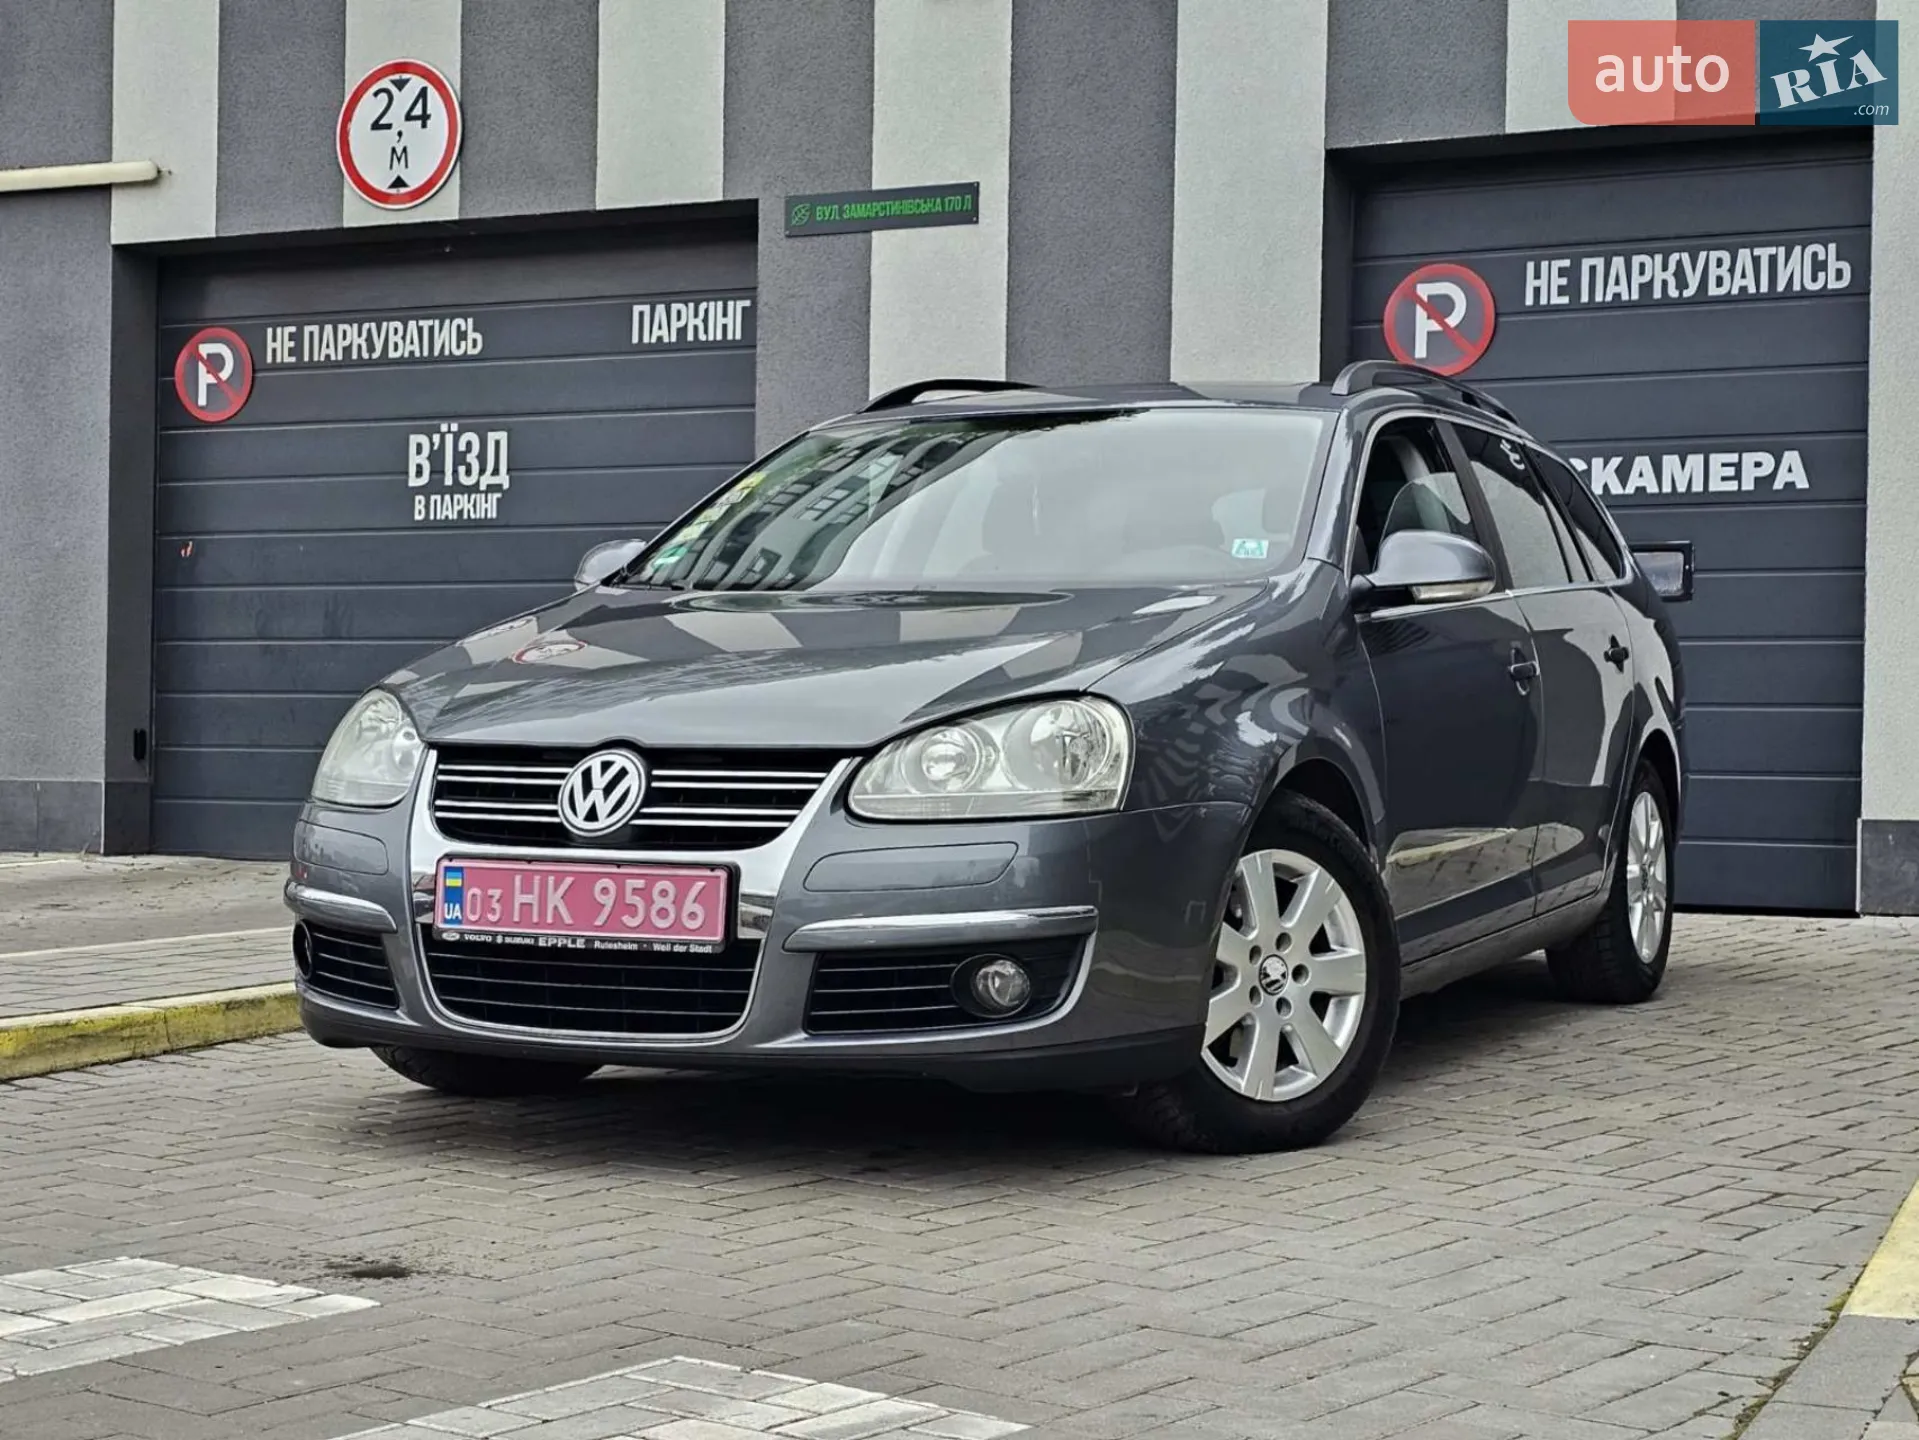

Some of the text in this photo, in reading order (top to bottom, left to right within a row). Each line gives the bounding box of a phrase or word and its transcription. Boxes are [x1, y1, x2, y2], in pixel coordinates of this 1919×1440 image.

[944, 195, 962, 212] 170
[963, 194, 972, 210] Л
[1525, 243, 1852, 306] НЕ ПАРКУВАТИСЬ
[266, 317, 484, 363] НЕ ПАРКУВАТИСЬ
[631, 299, 751, 344] ПАРКІНГ
[1568, 450, 1810, 495] КАМЕРА
[414, 493, 503, 521] В ПАРКІНГ
[444, 903, 462, 920] UA
[466, 874, 708, 931] 03 HK 9586
[464, 933, 492, 942] VOLVO
[538, 936, 586, 949] EPPLE
[653, 942, 671, 952] Weil
[673, 943, 687, 953] der
[689, 943, 713, 954] Stadt
